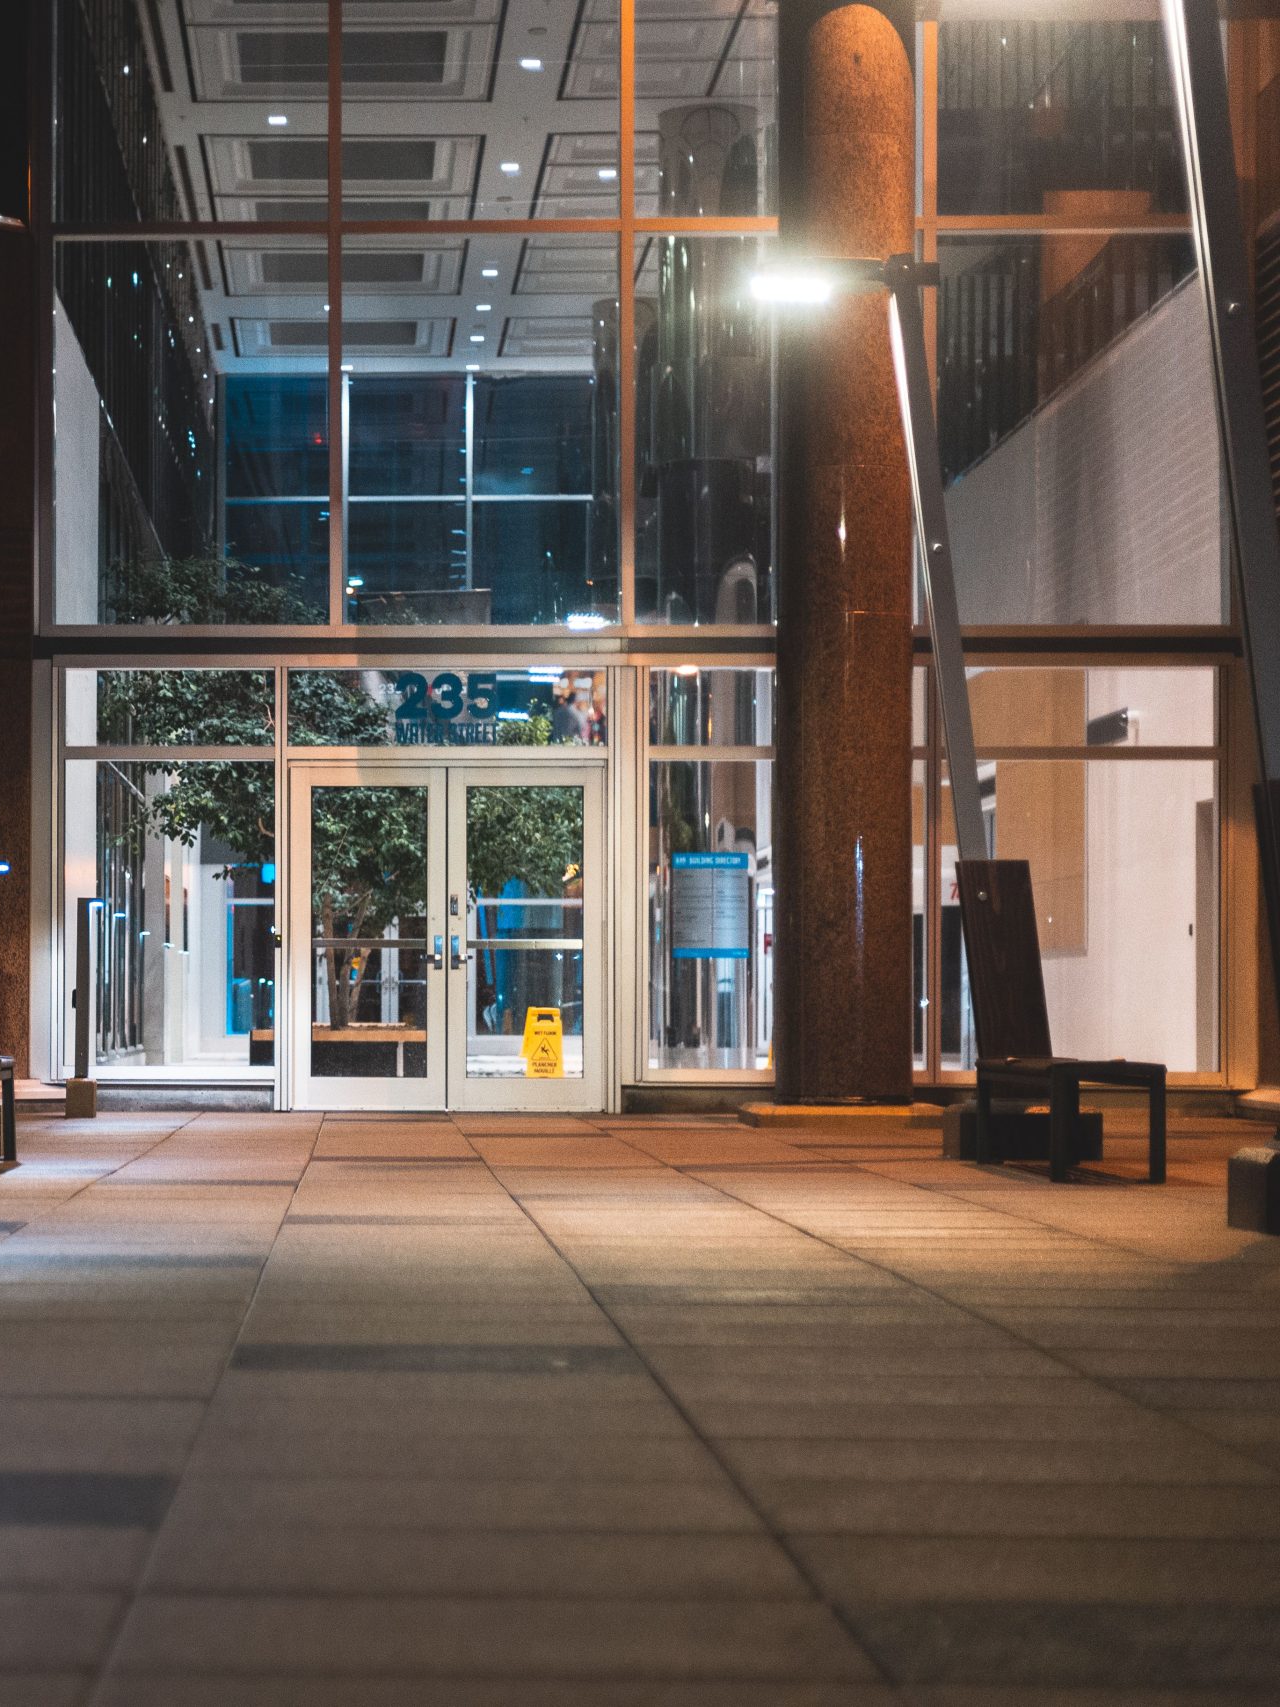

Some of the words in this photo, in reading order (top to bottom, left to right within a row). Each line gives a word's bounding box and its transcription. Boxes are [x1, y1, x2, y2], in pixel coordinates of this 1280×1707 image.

[396, 672, 496, 719] 235
[396, 722, 444, 746] WATER
[448, 722, 496, 746] STREET
